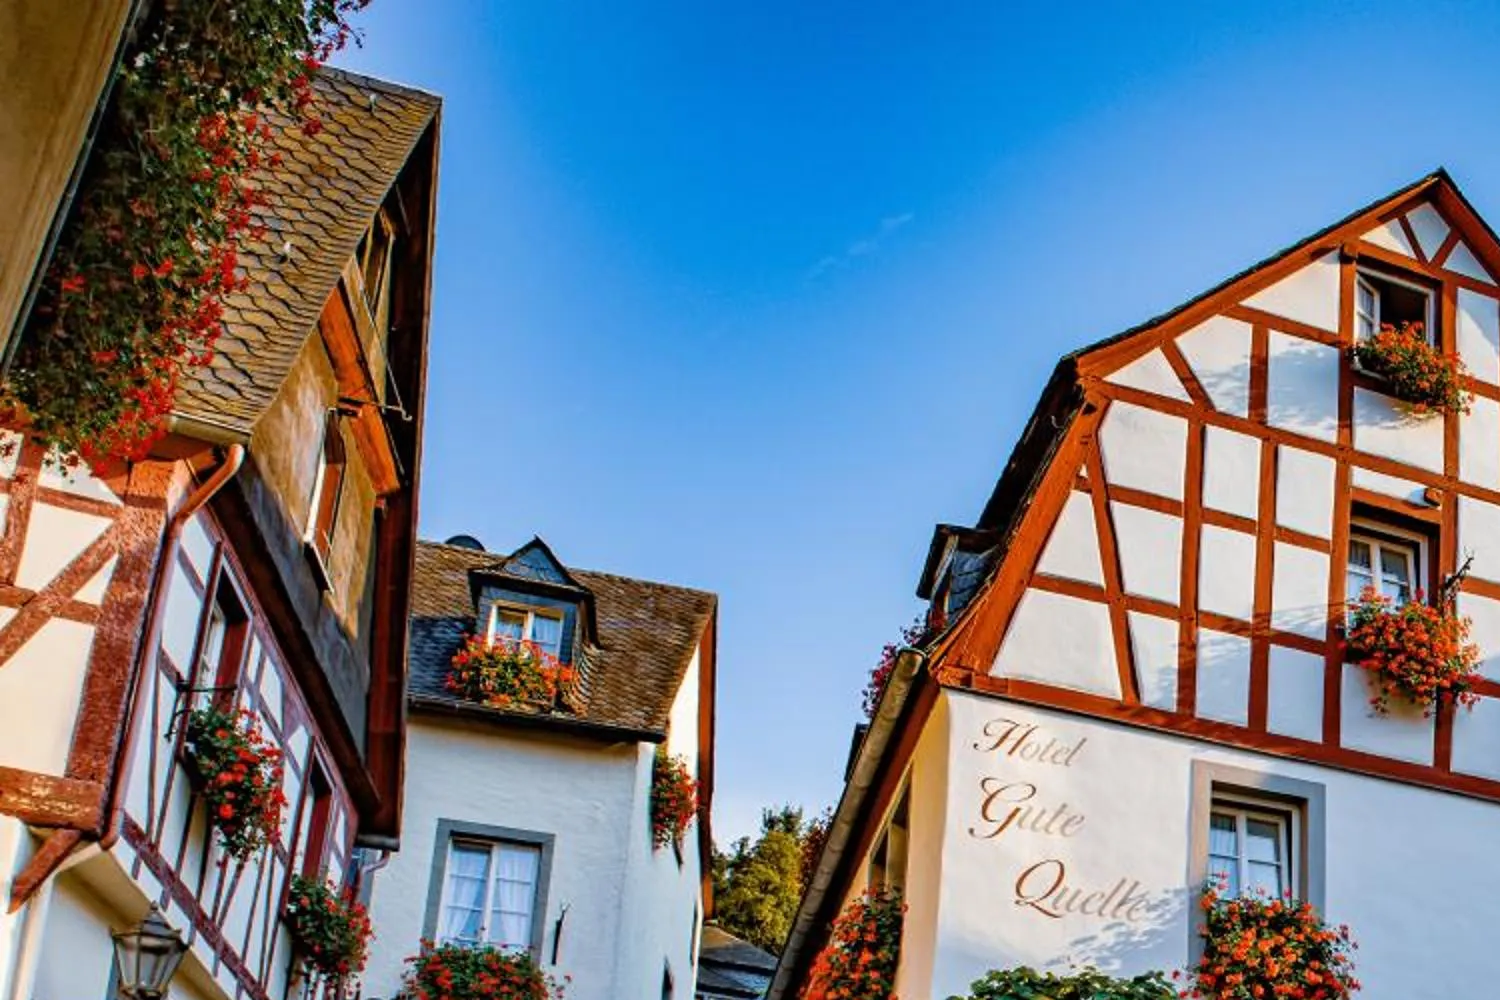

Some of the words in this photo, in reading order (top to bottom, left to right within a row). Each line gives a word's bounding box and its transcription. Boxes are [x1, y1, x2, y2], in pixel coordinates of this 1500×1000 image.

[973, 717, 1088, 768] Hotel
[968, 776, 1087, 839] Gute
[1013, 858, 1152, 924] Quelle
